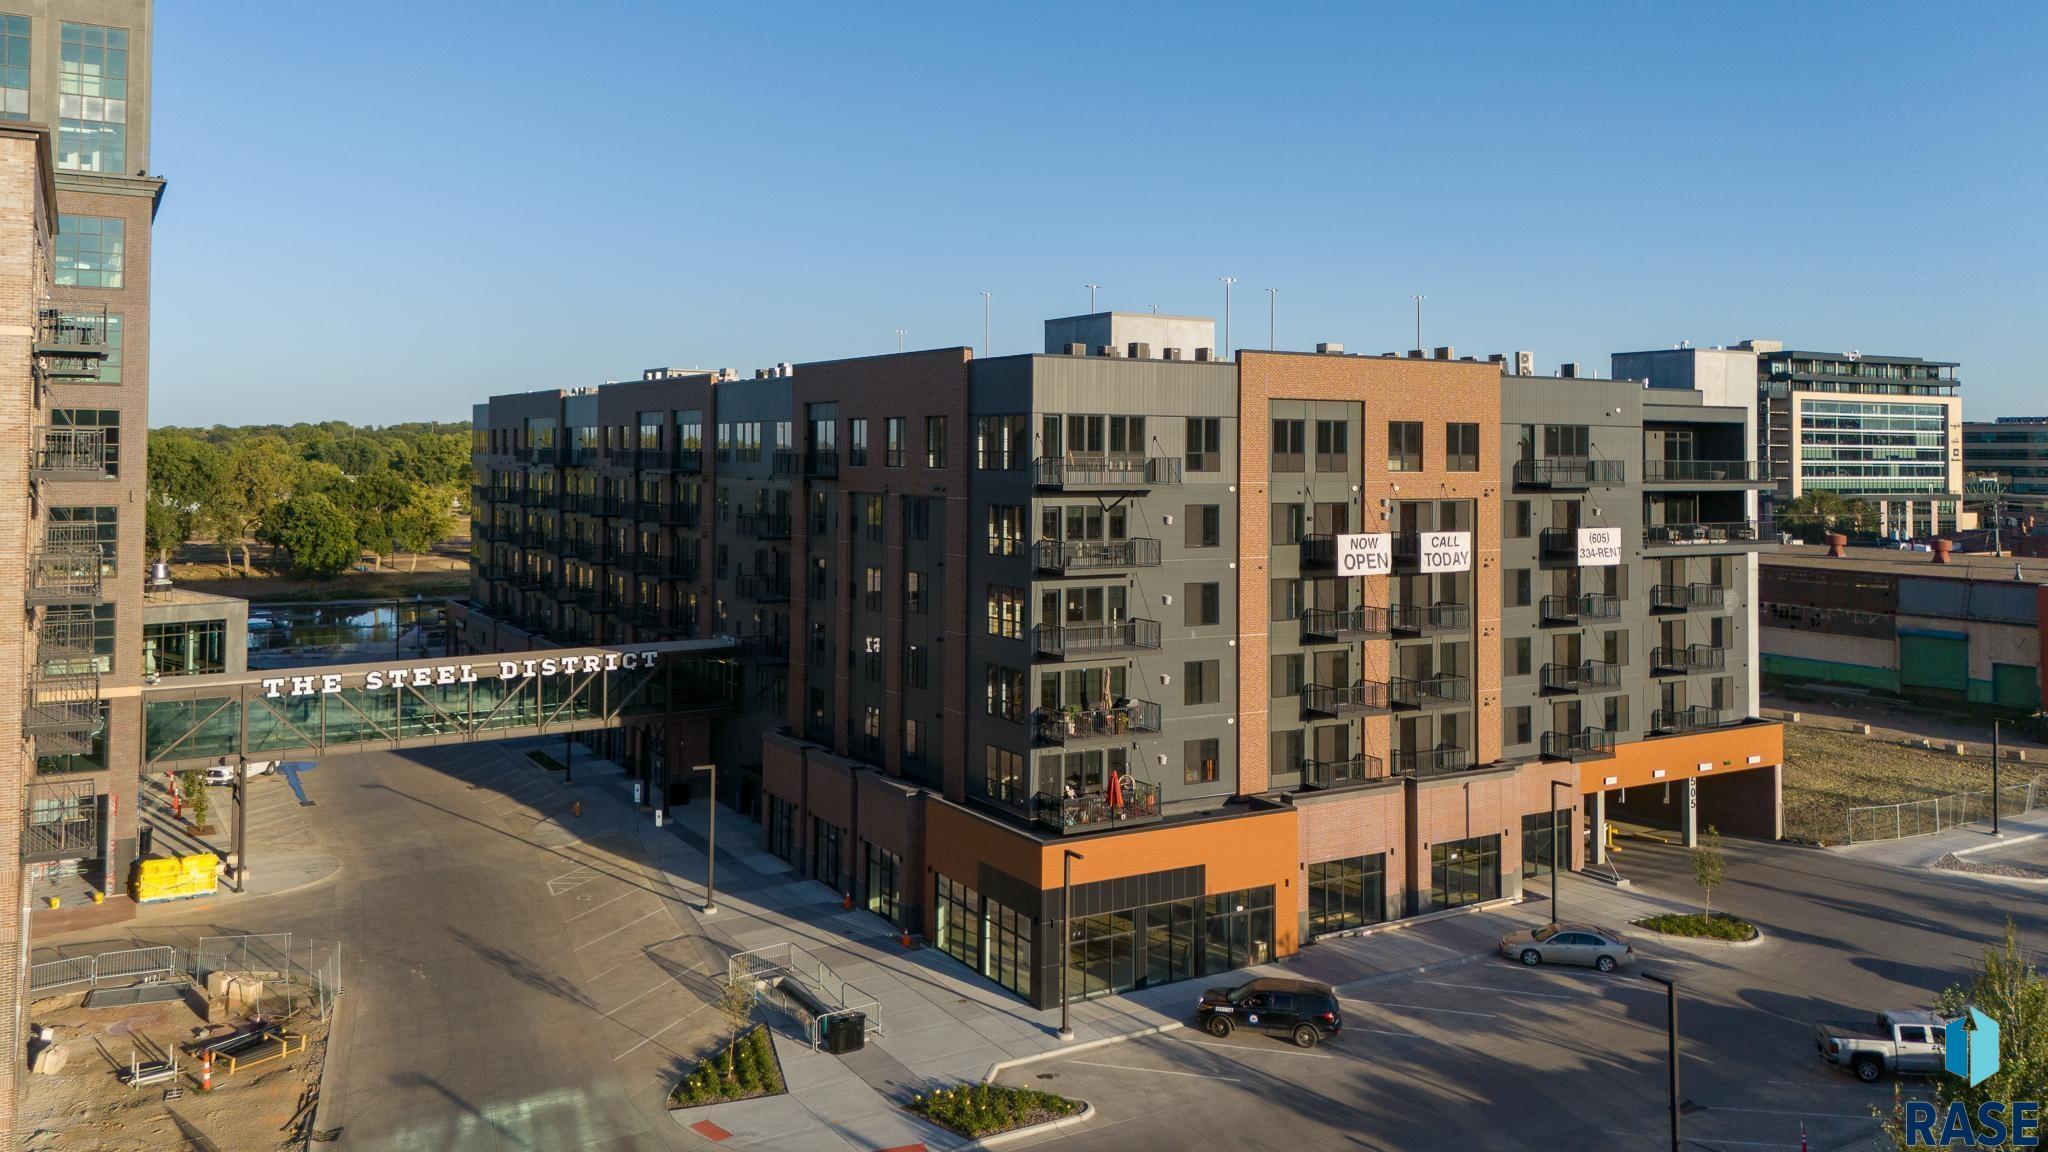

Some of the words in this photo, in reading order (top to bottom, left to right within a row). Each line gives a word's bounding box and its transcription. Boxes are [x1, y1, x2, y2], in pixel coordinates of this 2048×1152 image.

[1350, 537, 1379, 550] NOW
[1431, 536, 1460, 548] CALL
[1589, 532, 1609, 544] (605)
[1424, 551, 1469, 567] TODAY
[1580, 547, 1621, 558] 334-RENT
[1344, 553, 1389, 570] OPEN
[262, 674, 342, 698] THE
[366, 665, 478, 690] STEEL
[499, 651, 658, 680] DISTRICT
